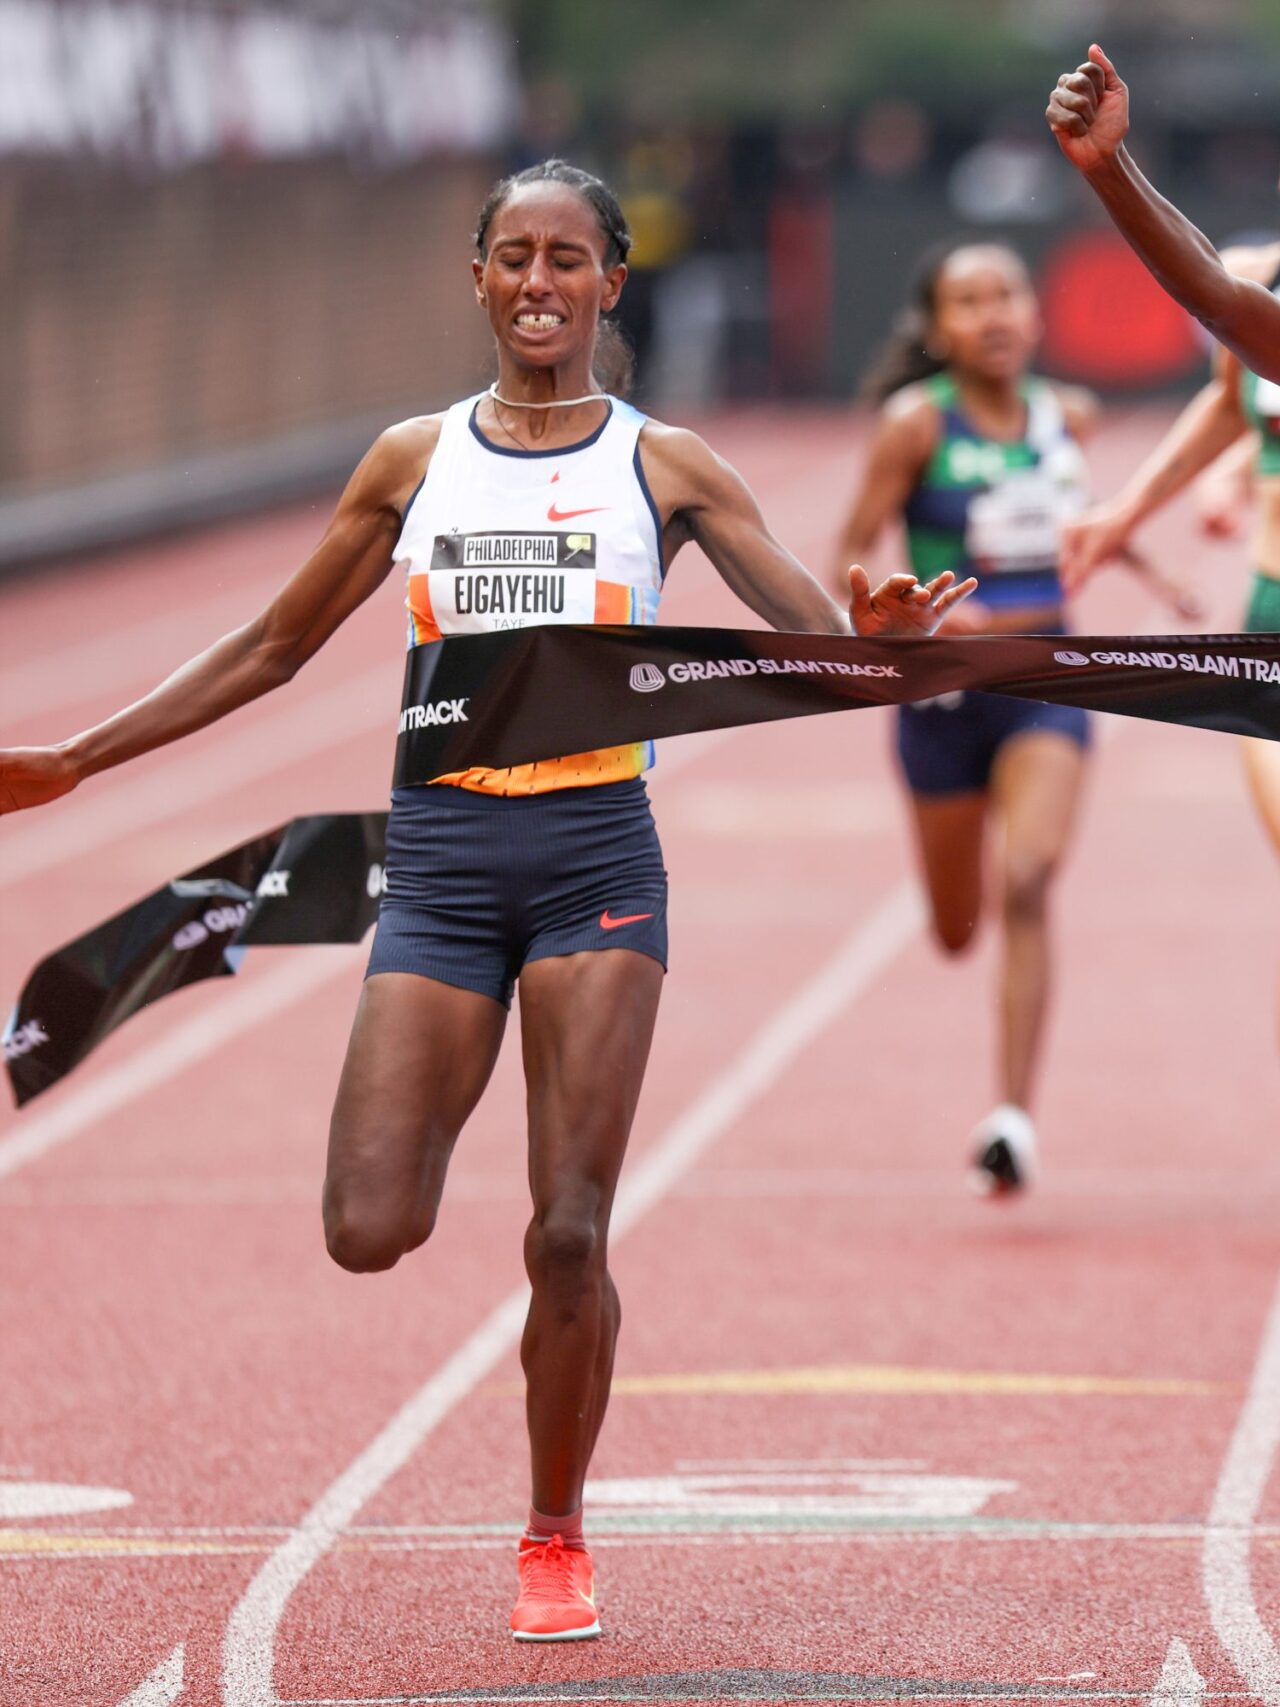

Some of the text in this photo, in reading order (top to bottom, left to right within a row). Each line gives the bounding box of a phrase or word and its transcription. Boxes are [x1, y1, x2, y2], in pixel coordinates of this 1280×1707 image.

[466, 539, 555, 563] PHILADELPHIA
[454, 575, 565, 615] EJGAYEHU
[668, 659, 903, 682] GRAND SLAM TRACK
[1091, 652, 1178, 670] GRAND
[1178, 653, 1239, 678] SLAM
